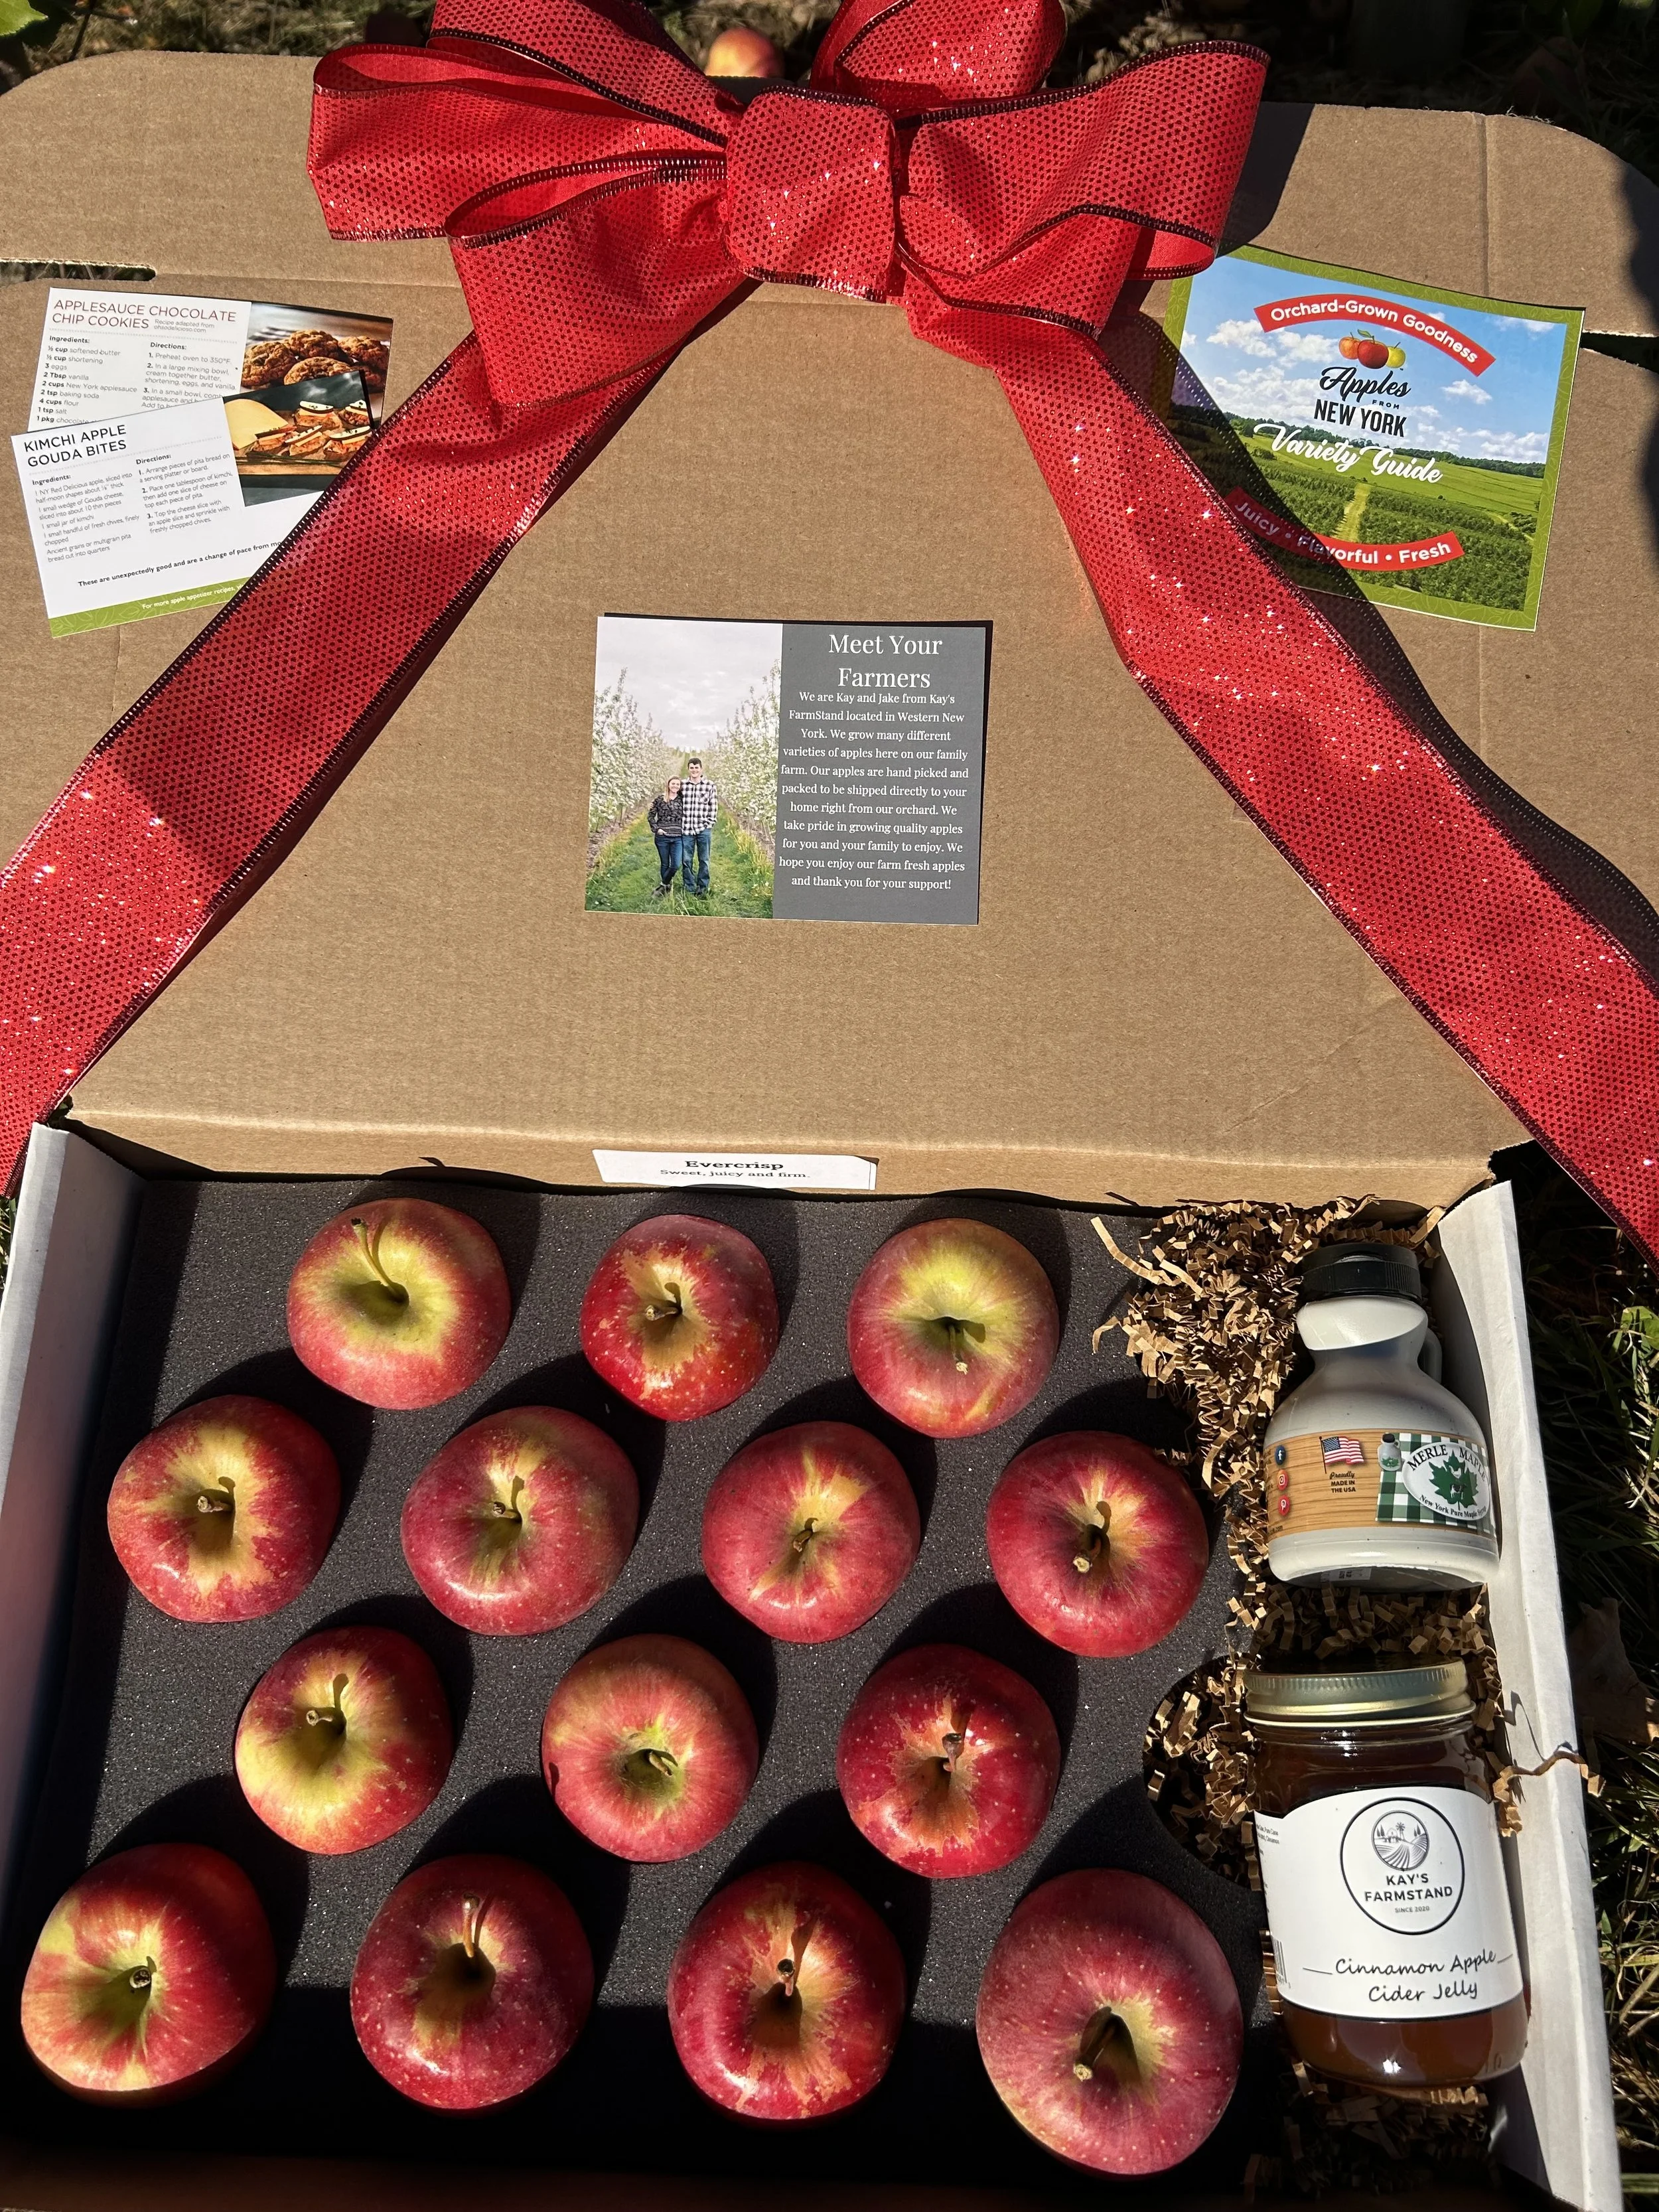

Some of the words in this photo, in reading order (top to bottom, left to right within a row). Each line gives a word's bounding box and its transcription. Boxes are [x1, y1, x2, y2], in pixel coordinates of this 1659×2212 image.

[53, 299, 145, 315] APPLESAUCE
[149, 305, 236, 321] CHOCOLATE
[52, 313, 84, 324] CHIP
[88, 315, 149, 329] COOKIES
[1270, 299, 1398, 321] Orchard-Grown
[1402, 313, 1479, 364] Goodness
[1320, 366, 1411, 402] Apples
[1372, 399, 1400, 410] FROM
[1314, 399, 1355, 425] NEW
[1360, 407, 1407, 437] YORK
[23, 433, 75, 452] KIMCHI
[80, 424, 126, 443] APPLE
[27, 449, 82, 467] GOUDA
[86, 439, 126, 456] BITES
[135, 454, 171, 465] Directions:
[1253, 423, 1362, 472] Variety
[1359, 446, 1443, 484] Guide
[32, 475, 70, 485] Ingredients:
[1234, 500, 1281, 536] Juicy
[1298, 534, 1378, 564] Flavorful
[1398, 541, 1451, 564] Fresh
[111, 567, 154, 579] unexpectedly
[156, 562, 172, 572] good
[186, 591, 212, 600] appetizer
[828, 634, 883, 654] Meet
[889, 635, 942, 654] Your
[837, 668, 930, 688] Farmers
[799, 692, 815, 701] We
[836, 692, 855, 703] Kay
[857, 692, 875, 702] and
[878, 692, 899, 704] Jake
[902, 693, 926, 703] from
[929, 694, 954, 705] Kay's
[789, 709, 843, 720] FarmStand
[845, 710, 882, 721] located
[885, 711, 895, 721] in
[897, 711, 939, 721] Western
[942, 712, 964, 722] New
[800, 728, 827, 738] York.
[830, 729, 845, 739] We
[847, 731, 874, 741] grow
[876, 732, 904, 742] many
[906, 730, 951, 741] different
[782, 746, 825, 757] varieties
[828, 747, 839, 757] of
[840, 747, 872, 759] apples
[875, 748, 898, 758] here
[936, 749, 968, 761] family
[780, 764, 807, 774] farm.
[810, 765, 830, 775] Our
[832, 766, 864, 777] apples
[886, 767, 911, 776] hand
[914, 767, 947, 778] picked
[950, 768, 968, 778] and
[782, 782, 817, 794] packed
[820, 784, 830, 794] to
[832, 784, 845, 794] be
[847, 784, 887, 796] shipped
[889, 785, 928, 798] directly
[930, 787, 940, 796] to
[943, 788, 967, 798] your
[790, 801, 818, 812] home
[821, 802, 846, 814] right
[848, 803, 873, 813] from
[895, 804, 938, 814] orchard.
[940, 805, 957, 815] We
[784, 820, 804, 830] take
[807, 820, 834, 832] pride
[837, 821, 847, 831] in
[849, 822, 891, 834] growing
[893, 823, 928, 835] quality
[930, 823, 962, 835] apples
[782, 838, 797, 848] for
[799, 841, 818, 850] you
[820, 839, 839, 849] and
[841, 842, 865, 851] your
[867, 840, 899, 853] family
[902, 842, 911, 851] to
[914, 842, 944, 853] enjoy.
[946, 842, 962, 852] We
[778, 855, 804, 868] hope
[806, 859, 824, 869] you
[827, 858, 854, 870] enjoy
[877, 859, 901, 869] farm
[903, 859, 930, 870] fresh
[932, 861, 965, 872] apples
[791, 875, 810, 885] and
[813, 875, 842, 886] thank
[844, 879, 863, 889] you
[865, 877, 881, 887] for
[882, 880, 906, 889] your
[908, 879, 950, 891] support!
[685, 1160, 783, 1170] Evercrisp
[1407, 1444, 1448, 1471] MERLE
[1459, 1447, 1486, 1481] MAPLE
[1419, 1494, 1433, 1507] New
[1433, 1502, 1449, 1514] York
[1386, 1872, 1429, 1885] KAY'S
[1364, 1886, 1453, 1903] FARMSTAND
[1334, 1957, 1445, 1976] Cinnamon
[1451, 1949, 1498, 1974] Apple
[1368, 1984, 1425, 2002] Cider
[1432, 1980, 1479, 2000] Jelly
